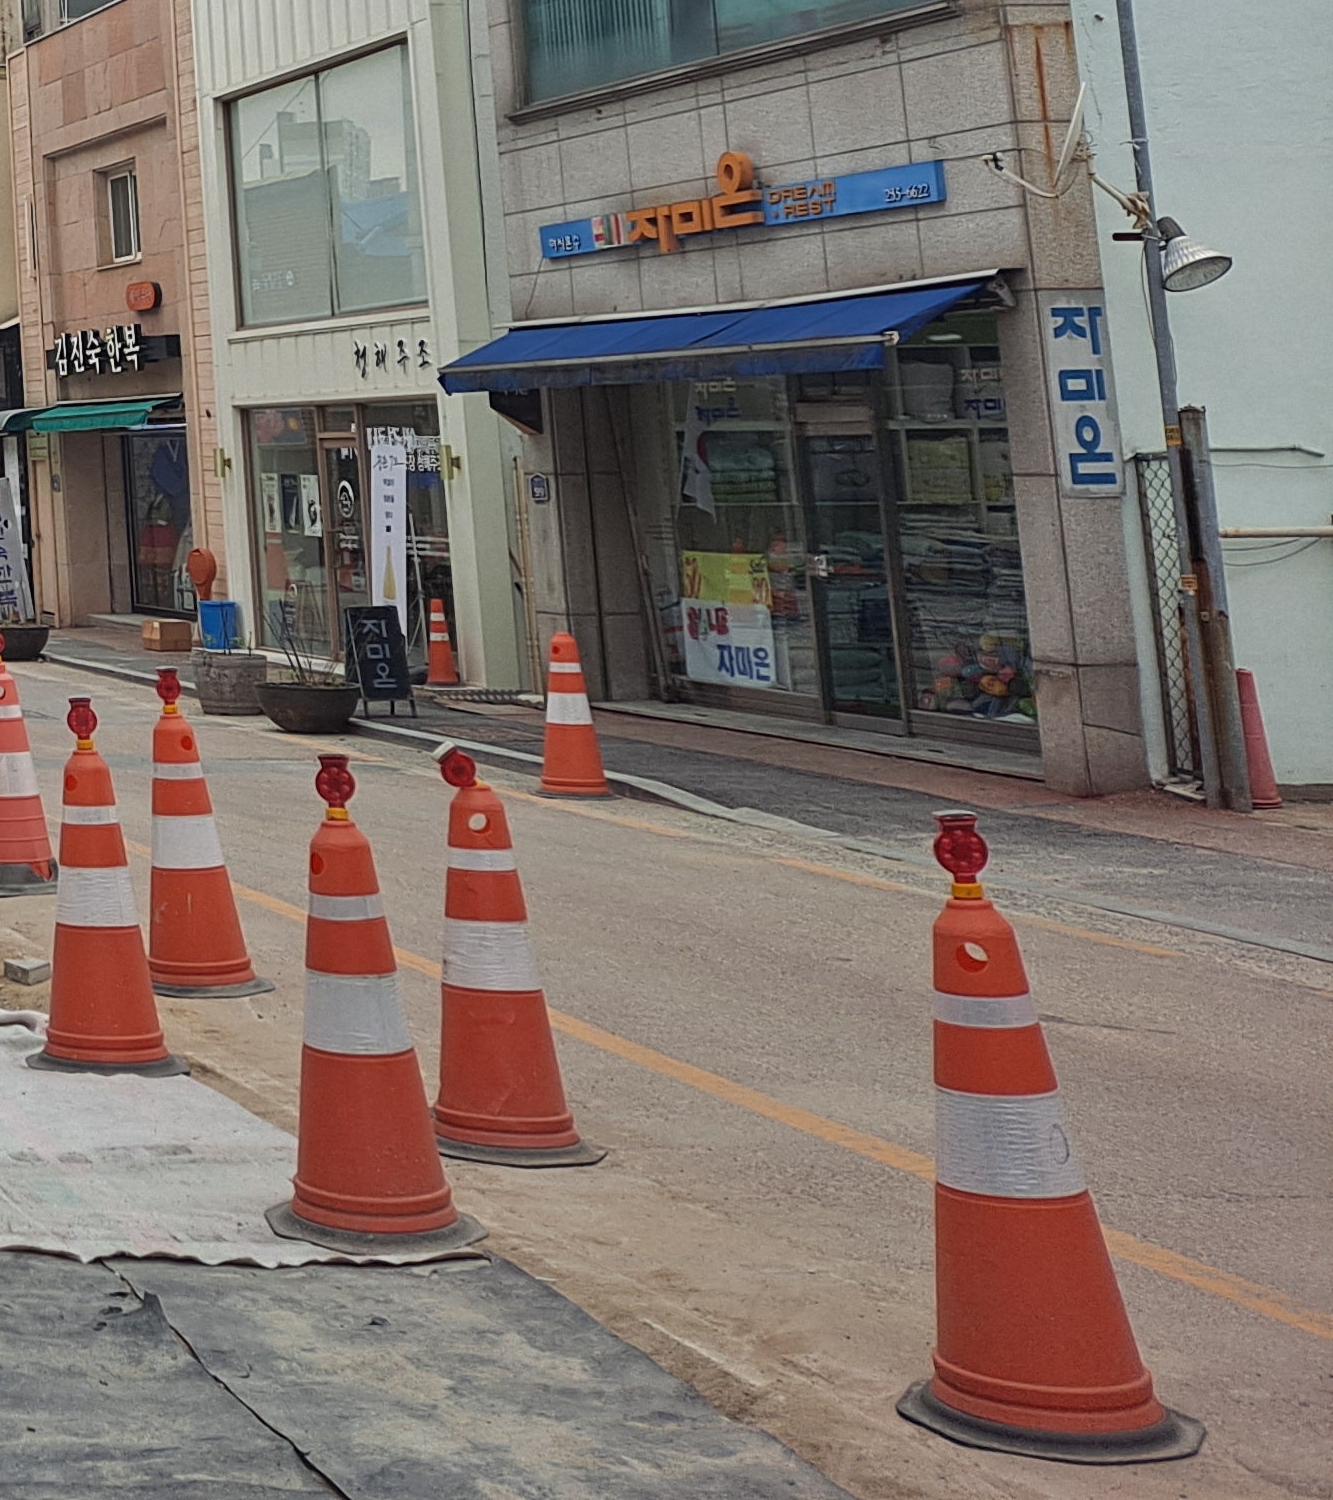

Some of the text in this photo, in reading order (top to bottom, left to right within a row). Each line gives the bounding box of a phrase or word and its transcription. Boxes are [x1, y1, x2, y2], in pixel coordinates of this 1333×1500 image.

[769, 181, 835, 204] DREAM
[785, 198, 836, 218] REST
[54, 323, 140, 376] 김진숙한복
